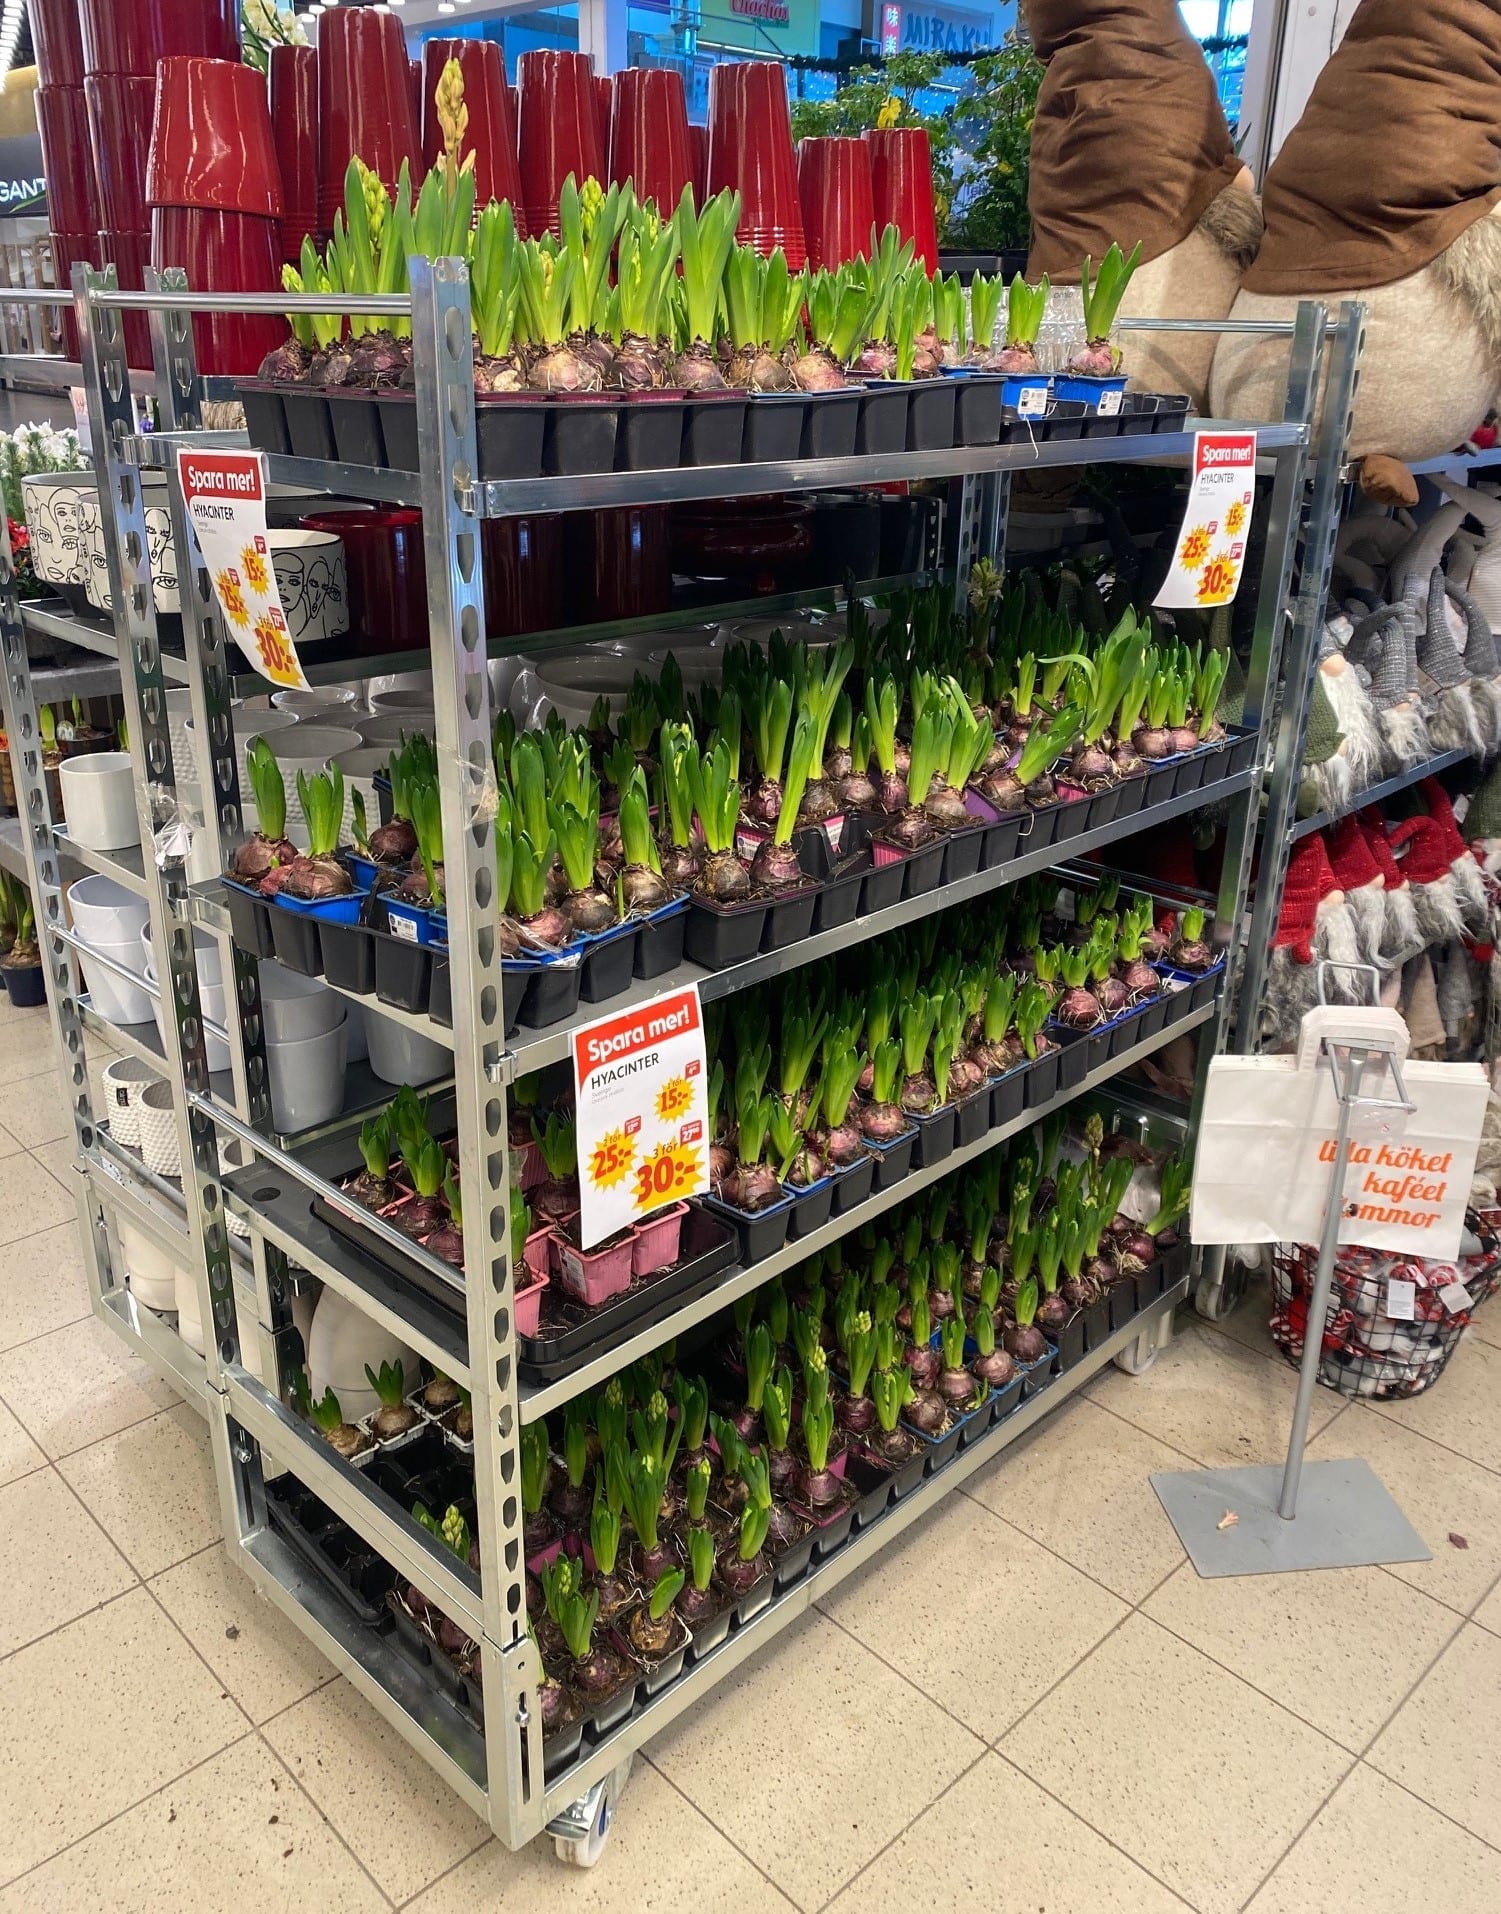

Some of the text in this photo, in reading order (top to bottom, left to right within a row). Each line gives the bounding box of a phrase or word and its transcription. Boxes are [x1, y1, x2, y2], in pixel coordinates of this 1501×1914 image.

[1202, 444, 1252, 466] Spara mer!
[188, 465, 256, 493] Spara mer!
[1200, 473, 1235, 484] HYACINTER
[193, 503, 235, 520] HYACINTER
[1182, 536, 1208, 559] 25:-
[1199, 564, 1234, 595] 30:-
[254, 628, 294, 673] 30:-
[587, 1003, 690, 1063] Spara mer!
[591, 1052, 660, 1090] HYACINTER
[660, 1087, 689, 1113] 15:-
[609, 1134, 622, 1144] för
[652, 1141, 679, 1160] 3 för
[593, 1144, 632, 1180] 25:-
[1318, 1140, 1453, 1174] lila köket
[637, 1156, 696, 1204] 30:-
[1363, 1171, 1447, 1203] kaféet
